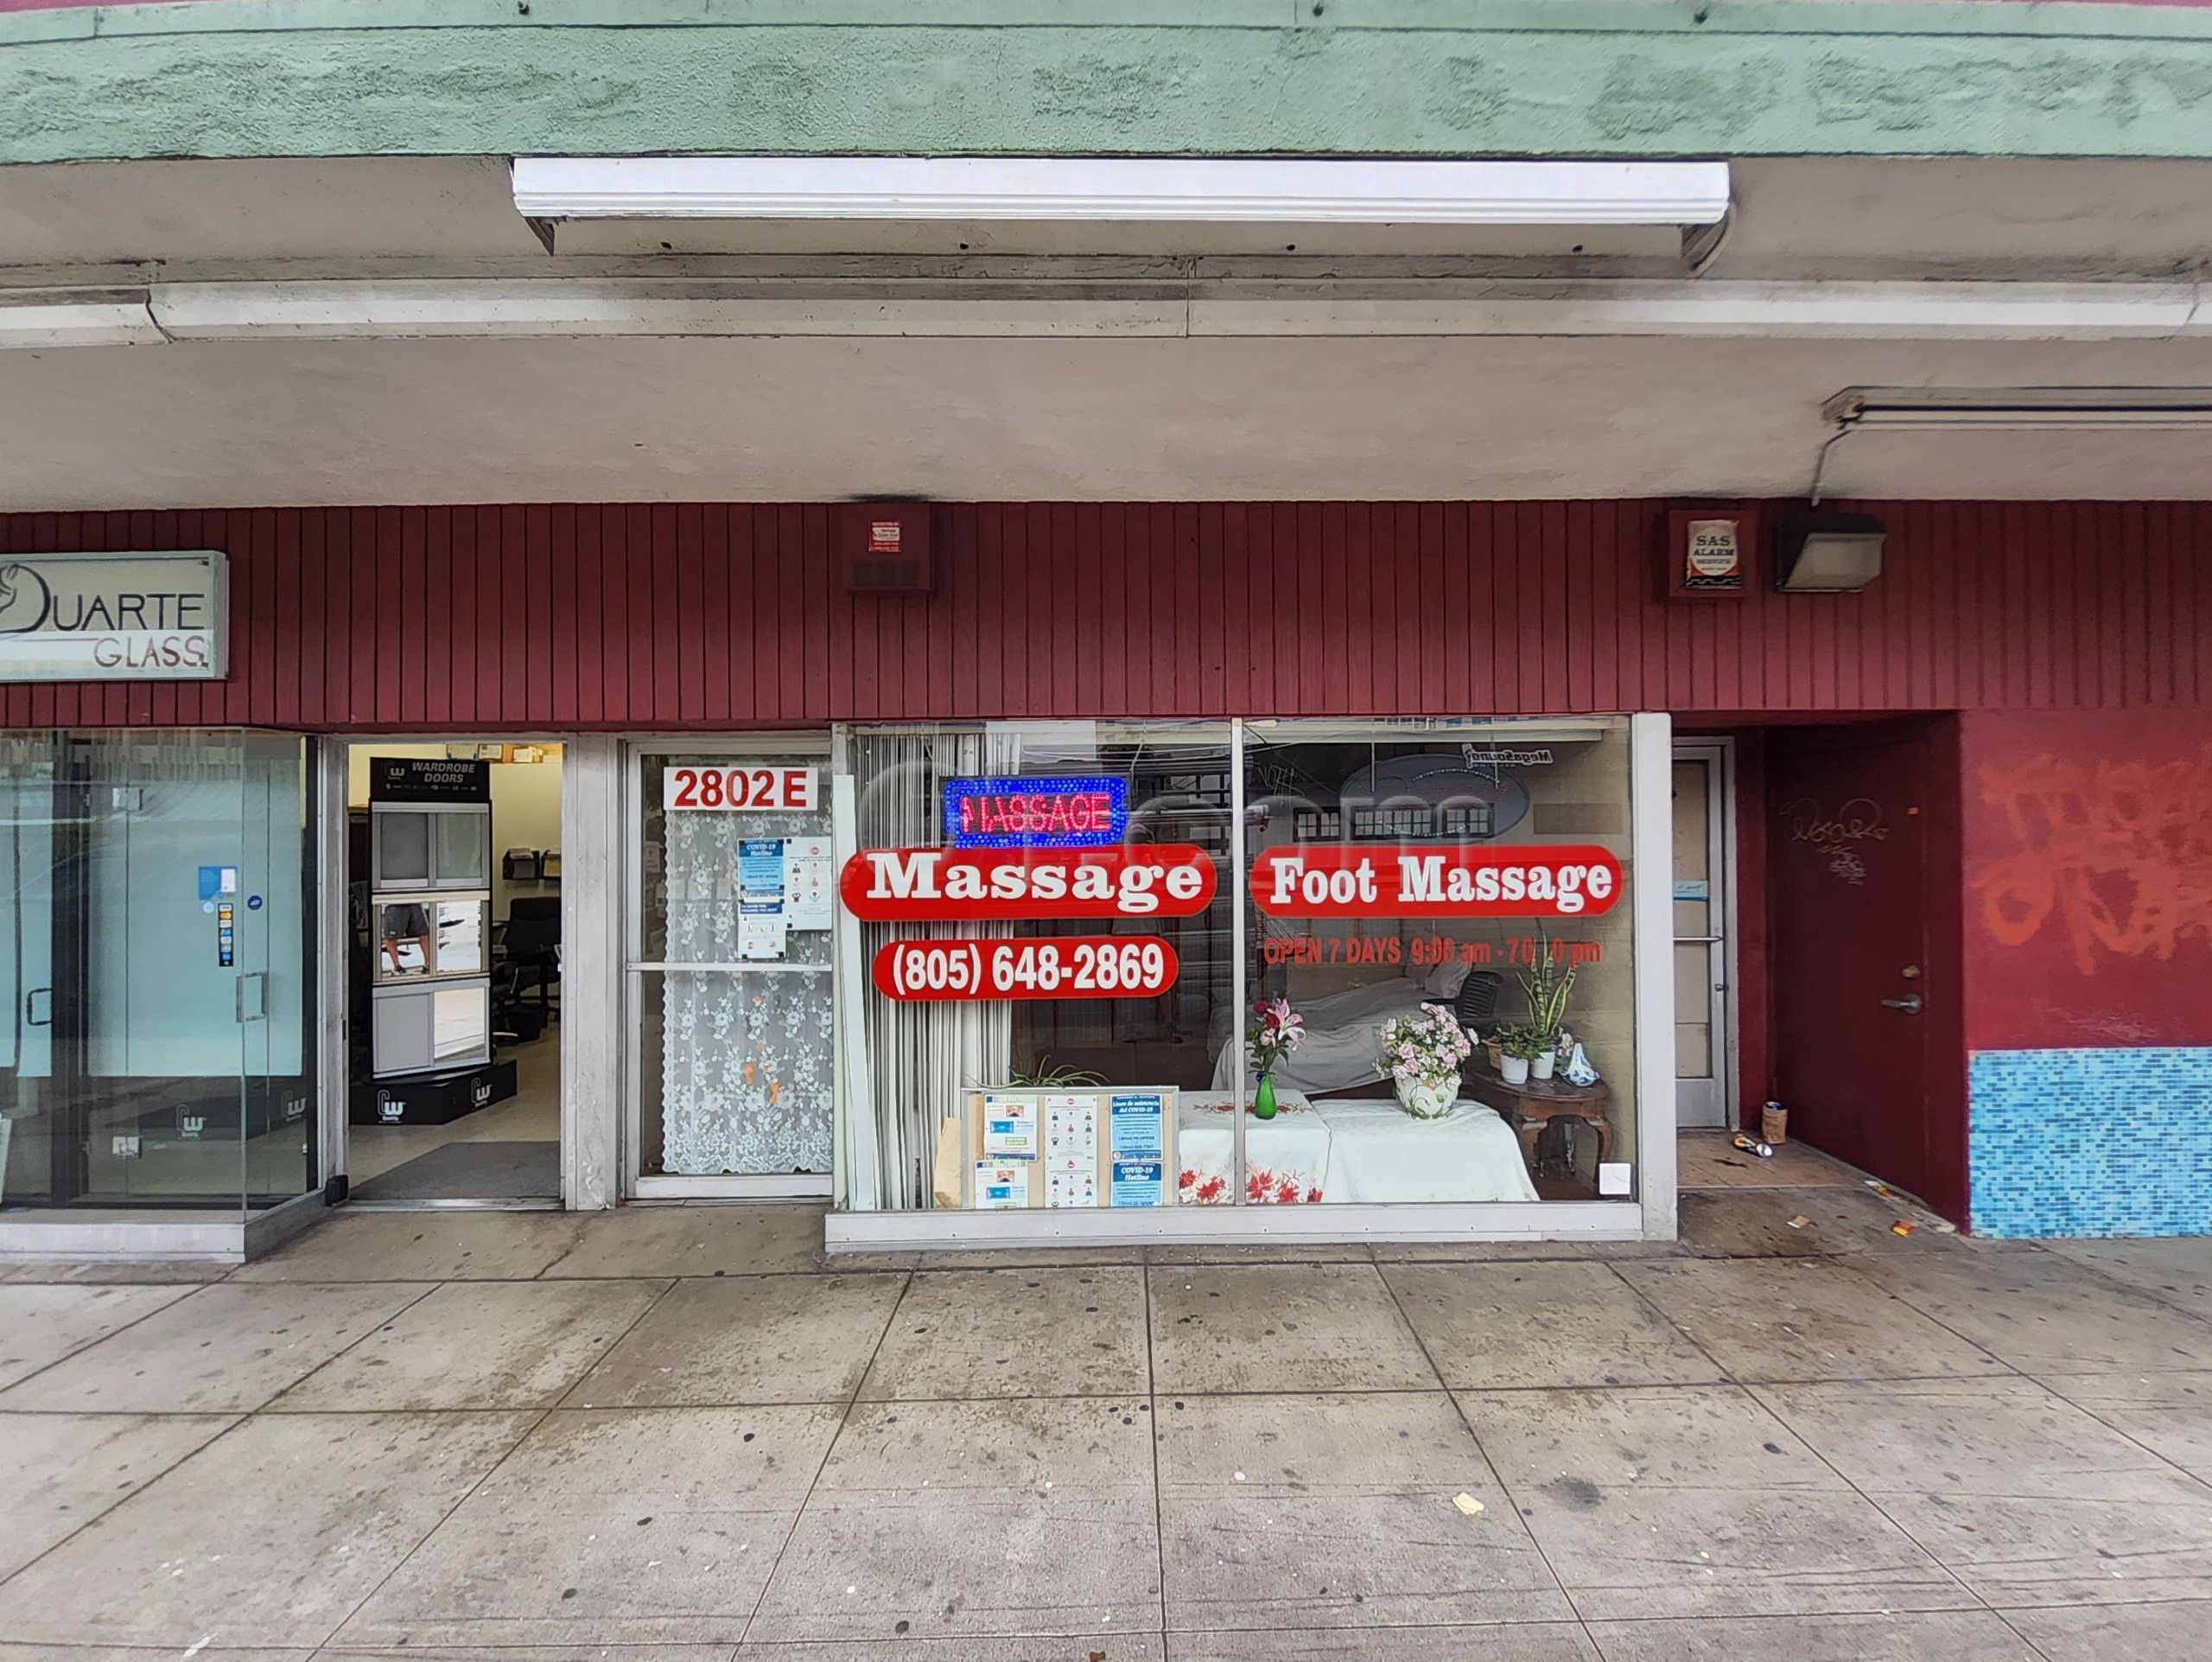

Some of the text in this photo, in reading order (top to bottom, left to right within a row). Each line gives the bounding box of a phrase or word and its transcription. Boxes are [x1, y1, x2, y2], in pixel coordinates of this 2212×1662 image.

[1697, 535, 1730, 546] SAS
[1693, 548, 1734, 557] ALARM
[94, 635, 209, 668] GLASS
[411, 761, 476, 774] WARDROBE
[423, 773, 465, 783] DOORS
[866, 851, 1204, 914] Massage
[1269, 856, 1612, 914] Foot Massage
[1264, 937, 1323, 965] OPEN
[1328, 938, 1341, 964] 7
[1345, 937, 1402, 964] DAYS
[1459, 941, 1492, 964] am
[1568, 940, 1603, 969] pm
[893, 944, 1165, 996] (805) 648-2869
[1121, 1166, 1154, 1175] COVID-19
